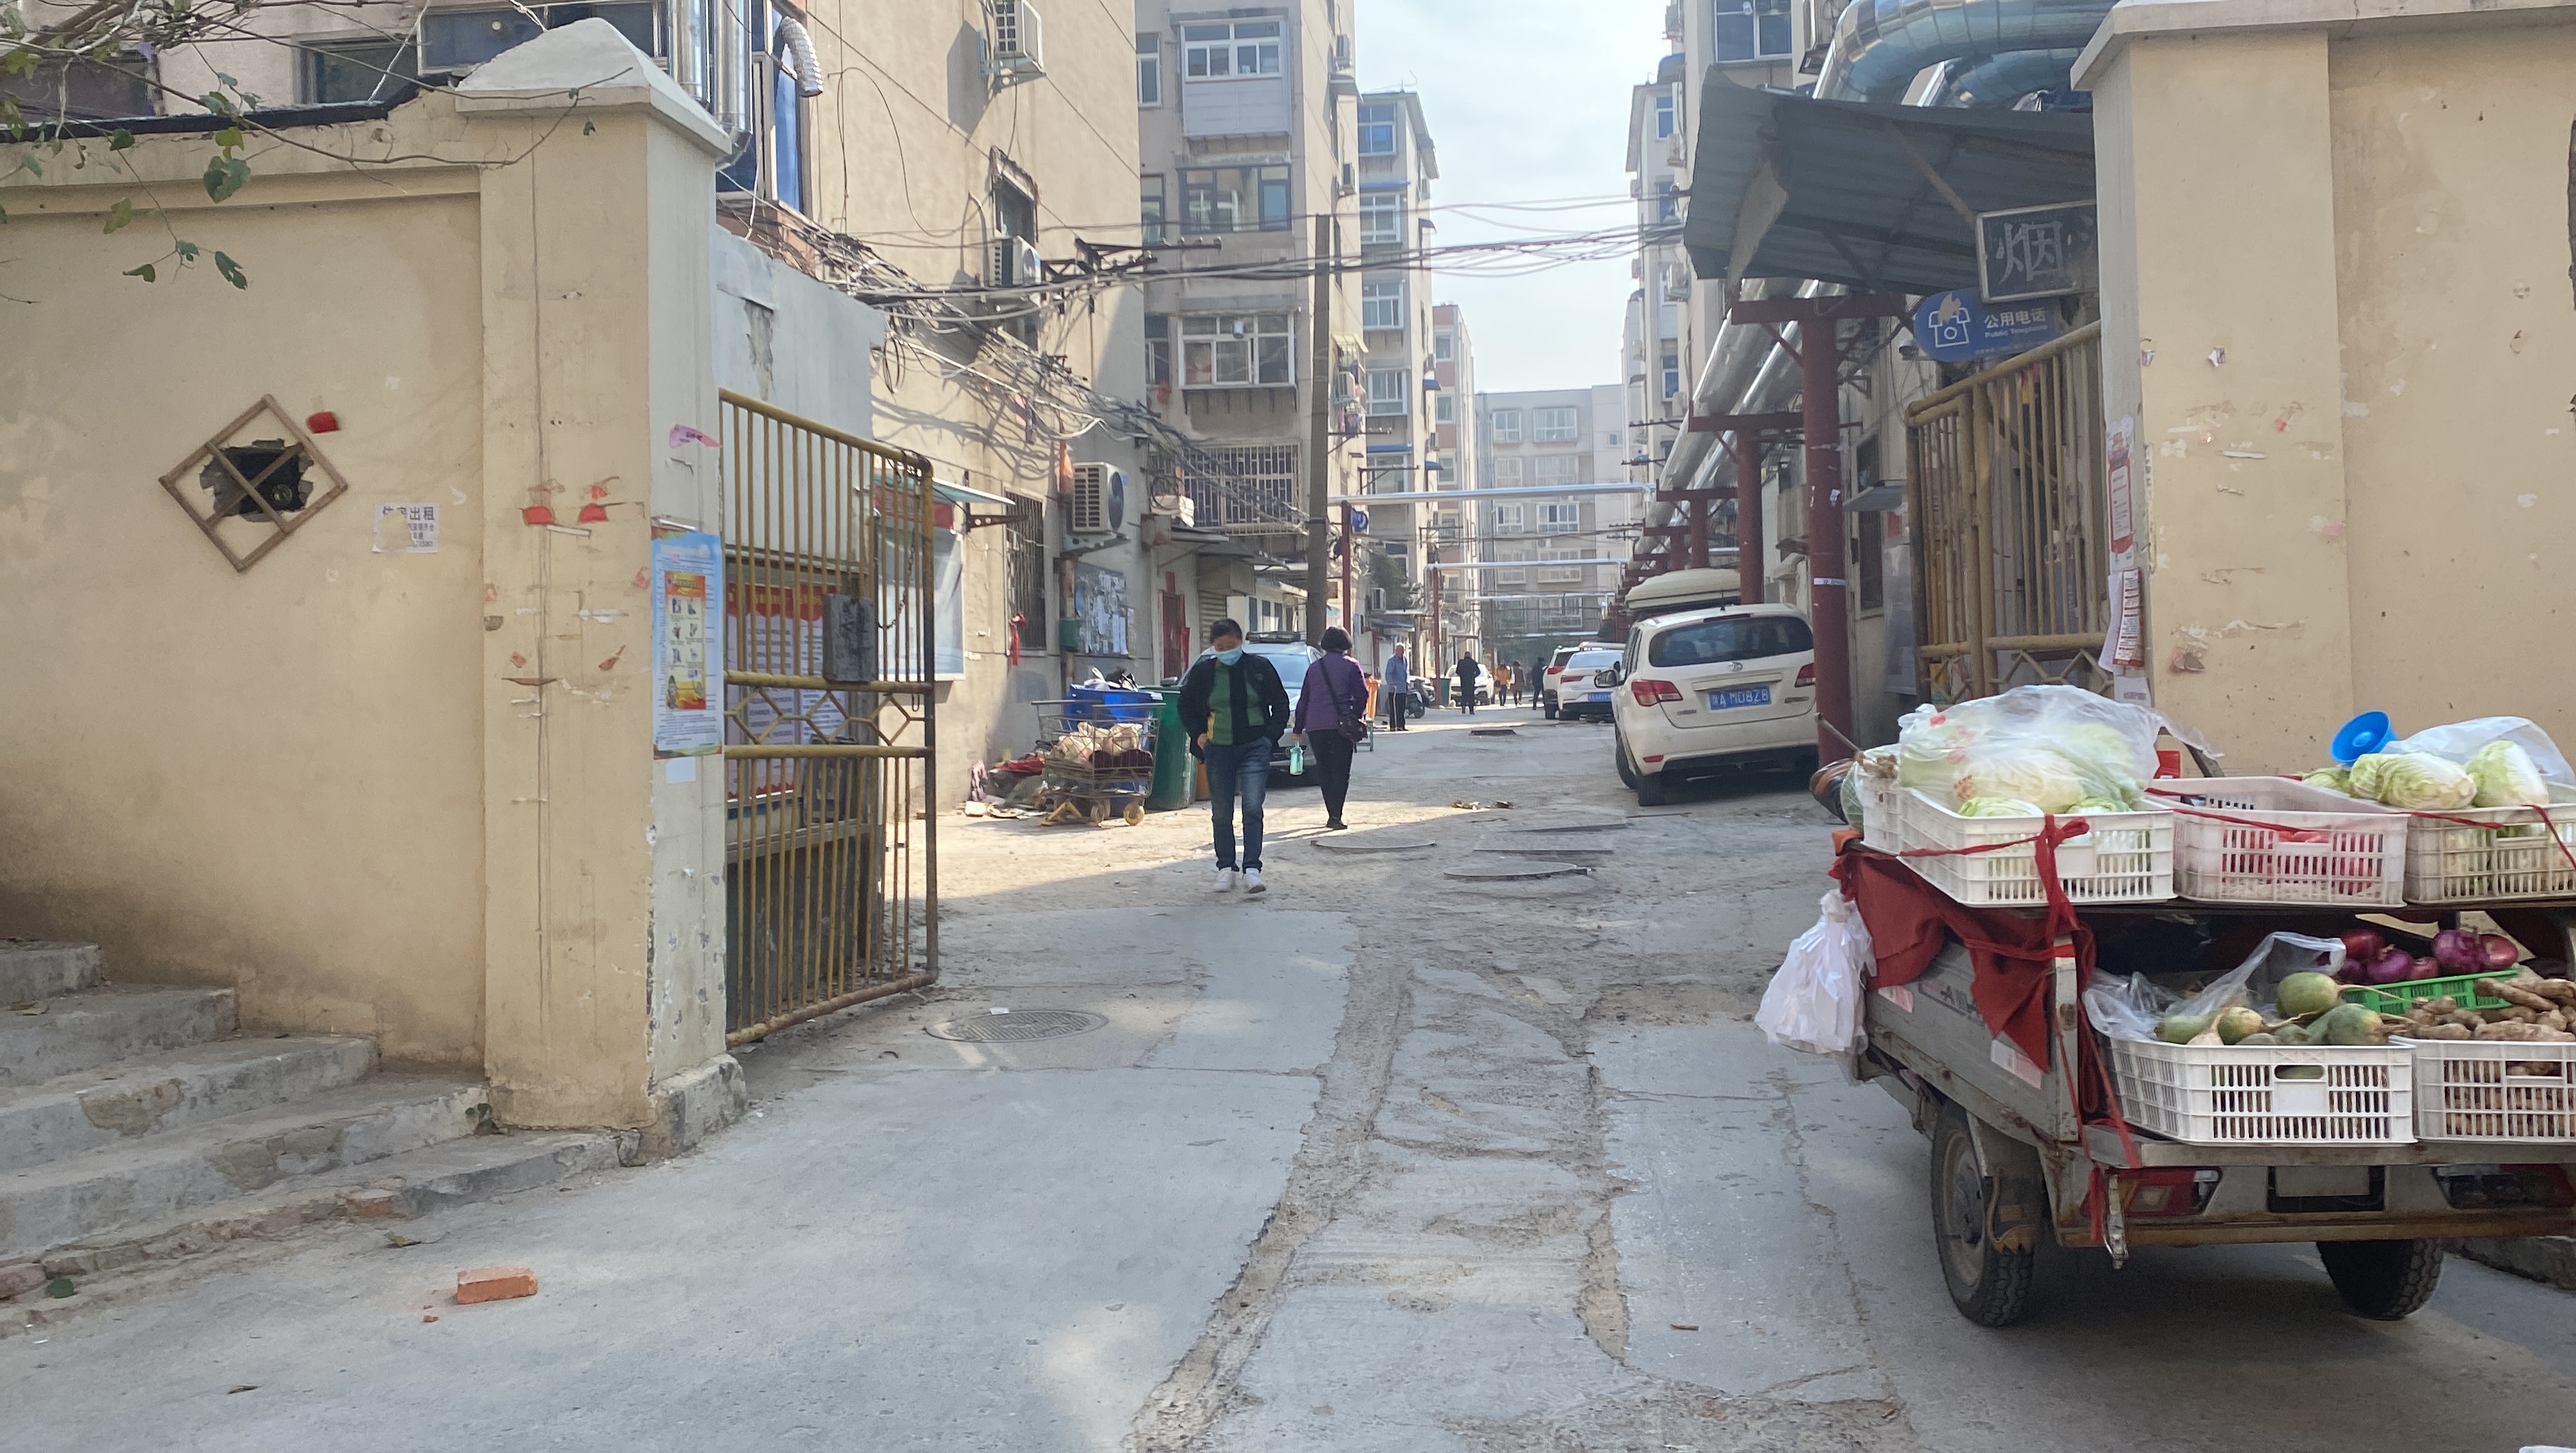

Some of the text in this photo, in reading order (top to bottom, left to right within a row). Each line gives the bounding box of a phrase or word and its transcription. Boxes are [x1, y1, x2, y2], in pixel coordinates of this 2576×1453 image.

[1996, 221, 2063, 285] 烟
[1985, 307, 2046, 328] 公用电话
